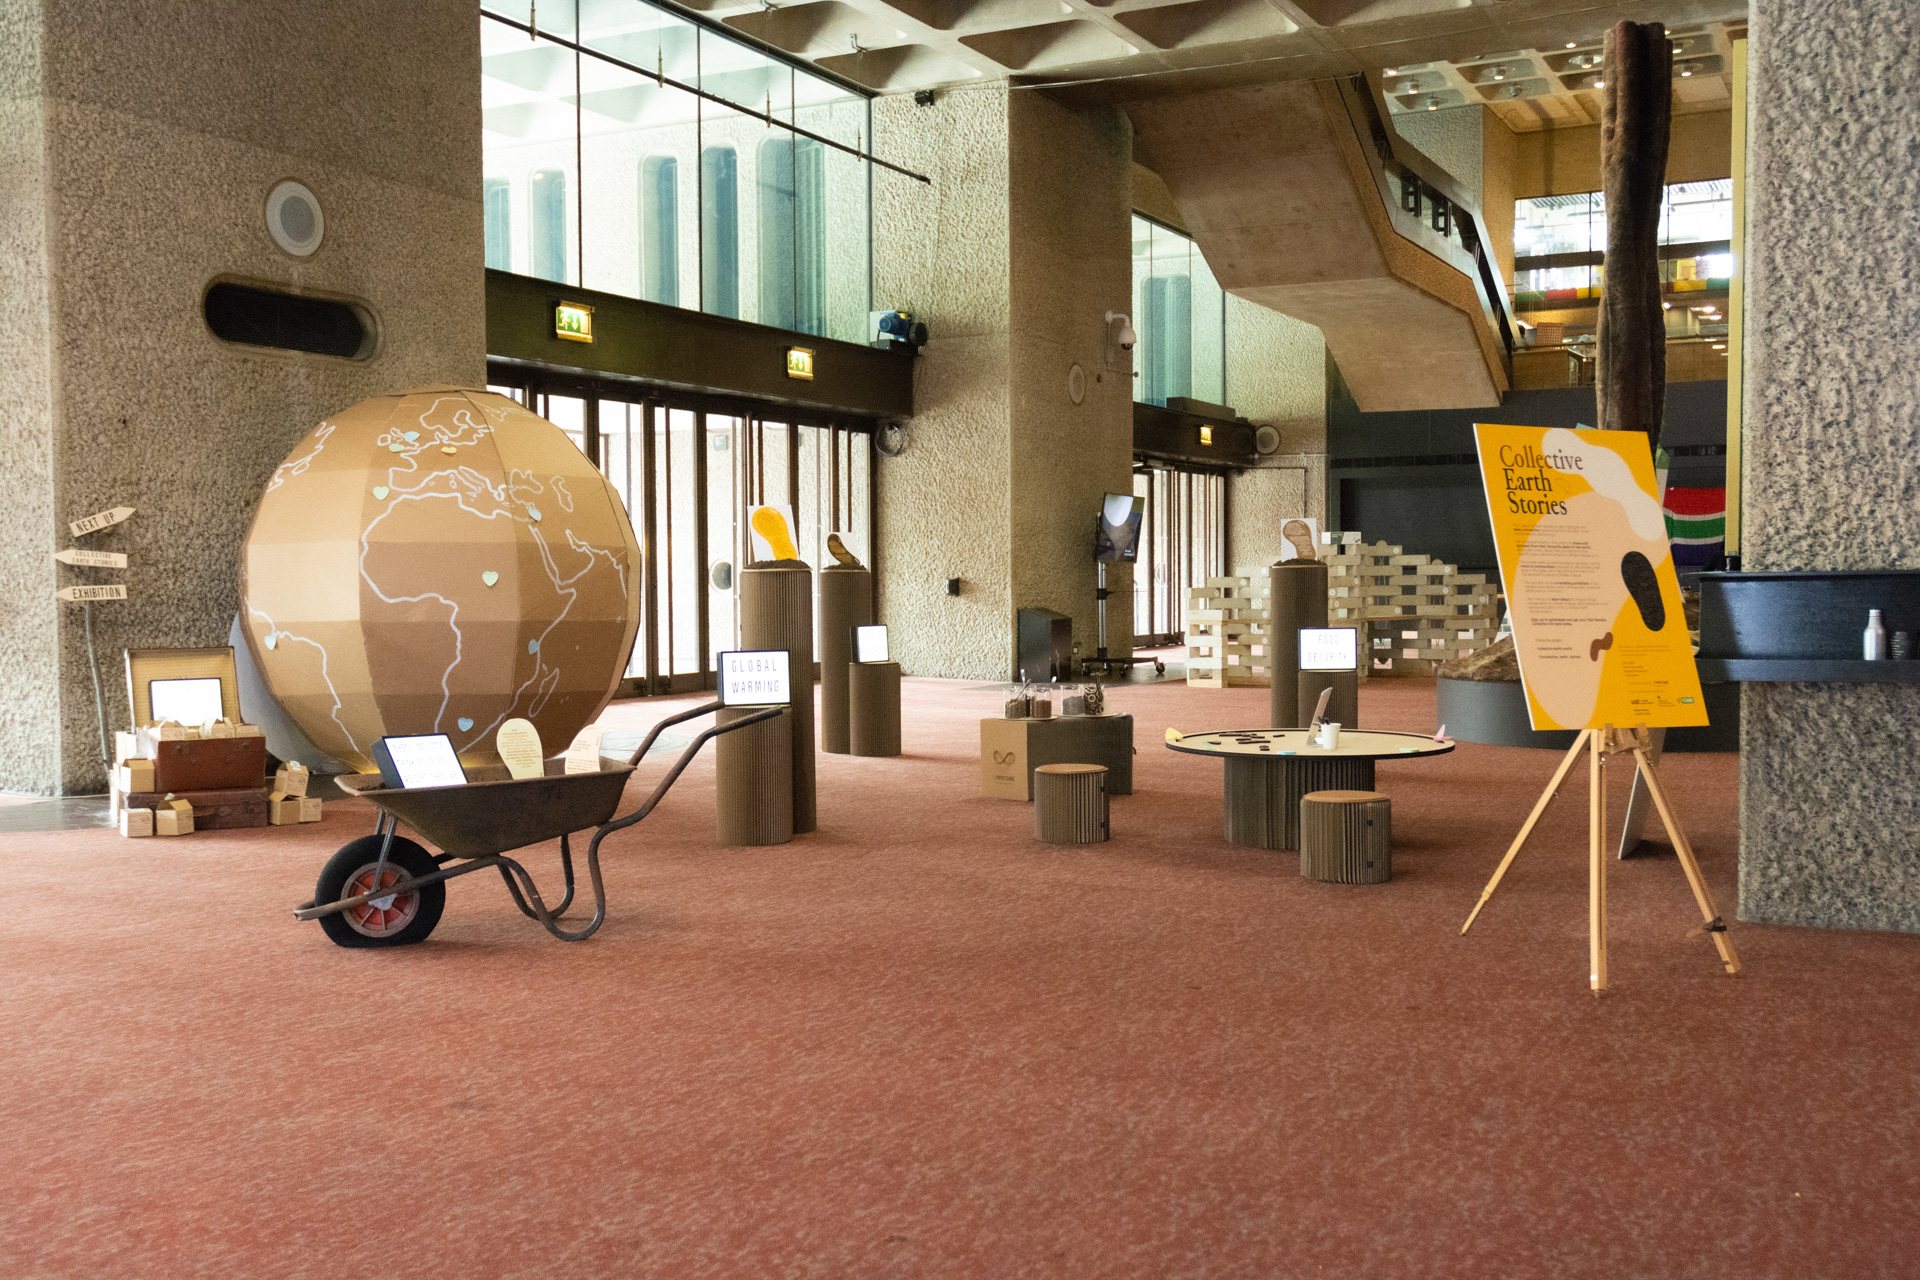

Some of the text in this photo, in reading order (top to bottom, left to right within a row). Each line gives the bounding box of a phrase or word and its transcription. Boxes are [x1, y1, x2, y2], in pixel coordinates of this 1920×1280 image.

[1499, 444, 1584, 471] Collective
[1502, 467, 1553, 492] Earth
[1507, 491, 1568, 516] Stories
[75, 512, 115, 533] NEXT UP
[75, 550, 111, 558] COLLECTIVE
[94, 558, 118, 567] STORIES
[72, 587, 122, 600] EXHIBITION
[1307, 651, 1348, 663] SECURITY
[731, 659, 776, 673] GLOBAL
[731, 679, 779, 695] WARMING
